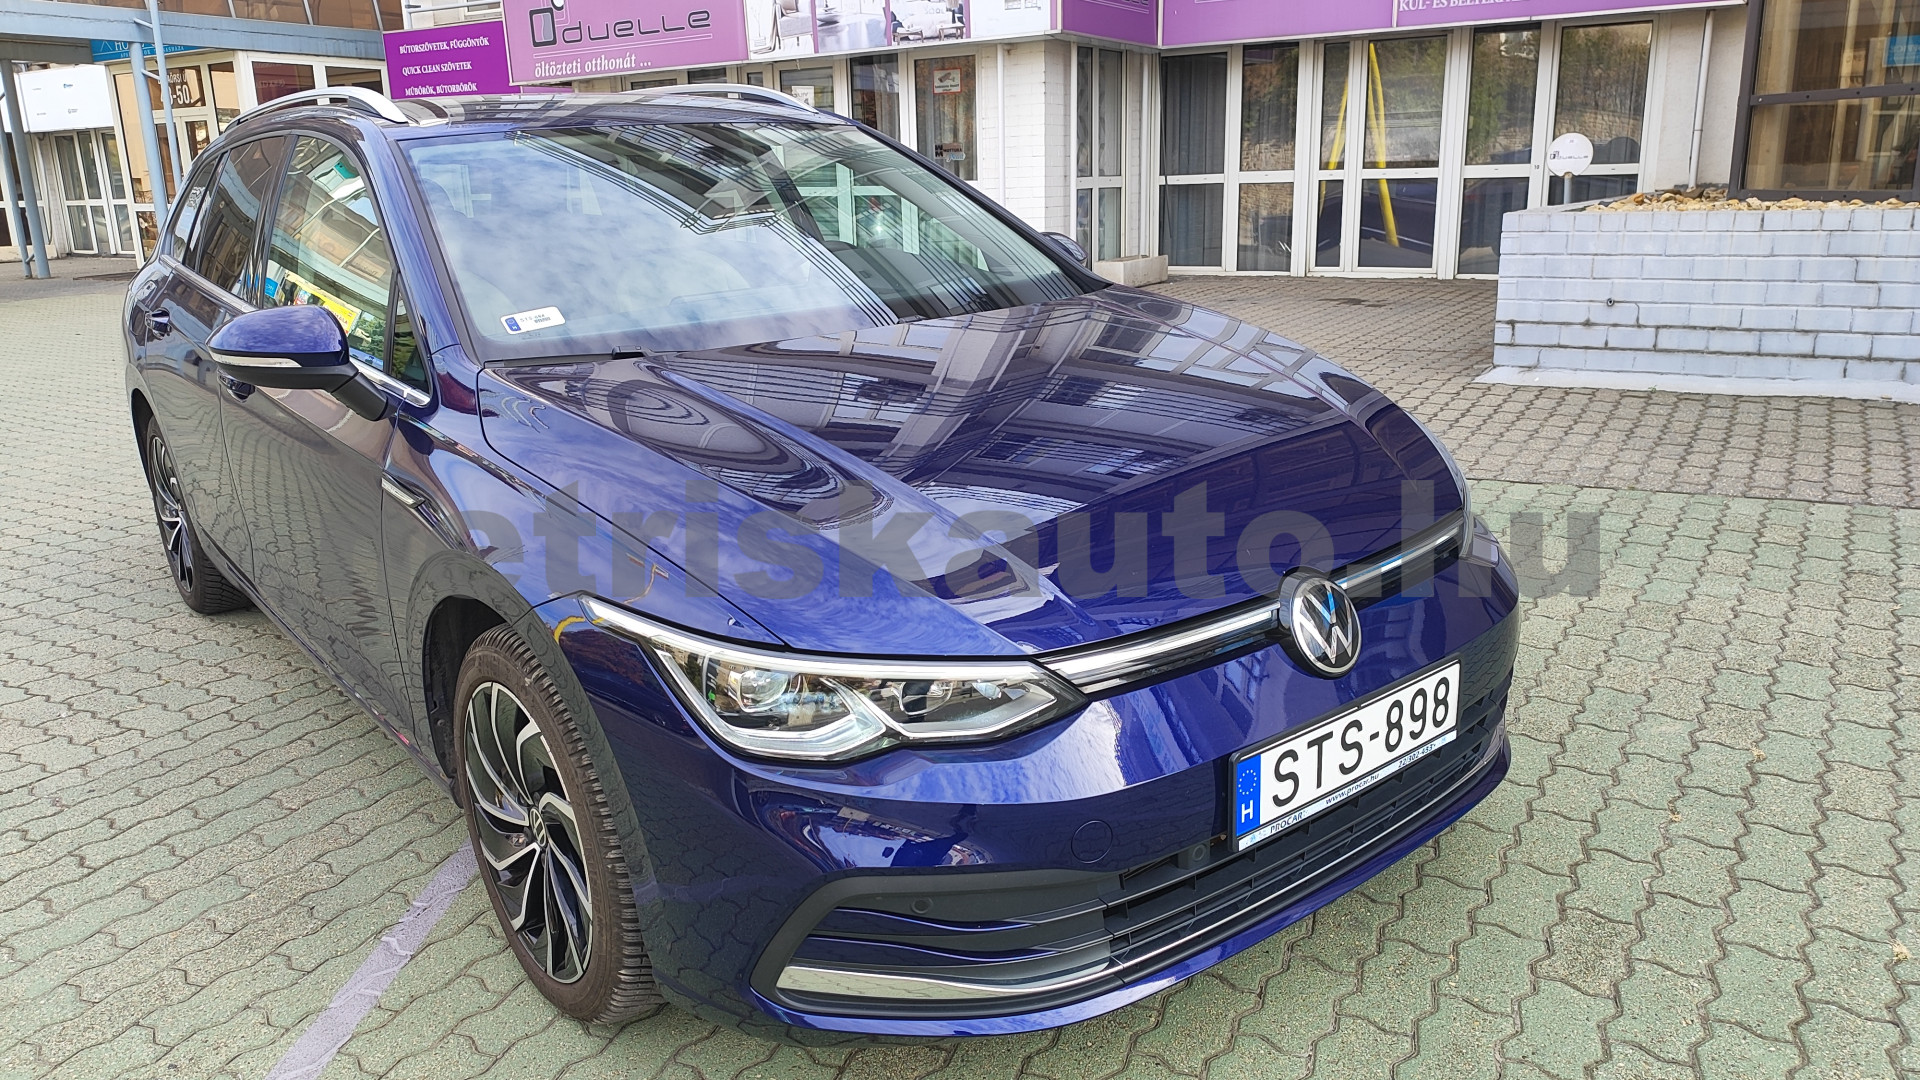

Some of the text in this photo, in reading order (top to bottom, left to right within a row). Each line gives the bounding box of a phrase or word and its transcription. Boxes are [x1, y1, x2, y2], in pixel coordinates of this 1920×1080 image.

[450, 36, 490, 49] FÜGGÖNYÖK
[402, 60, 472, 77] QUICK CLEAN SZÖVETEK
[535, 58, 581, 78] öltözteti
[585, 52, 636, 73] otthonát
[1272, 676, 1450, 808] STS-898
[1325, 773, 1380, 805] www.procar.hu
[1241, 799, 1254, 823] H
